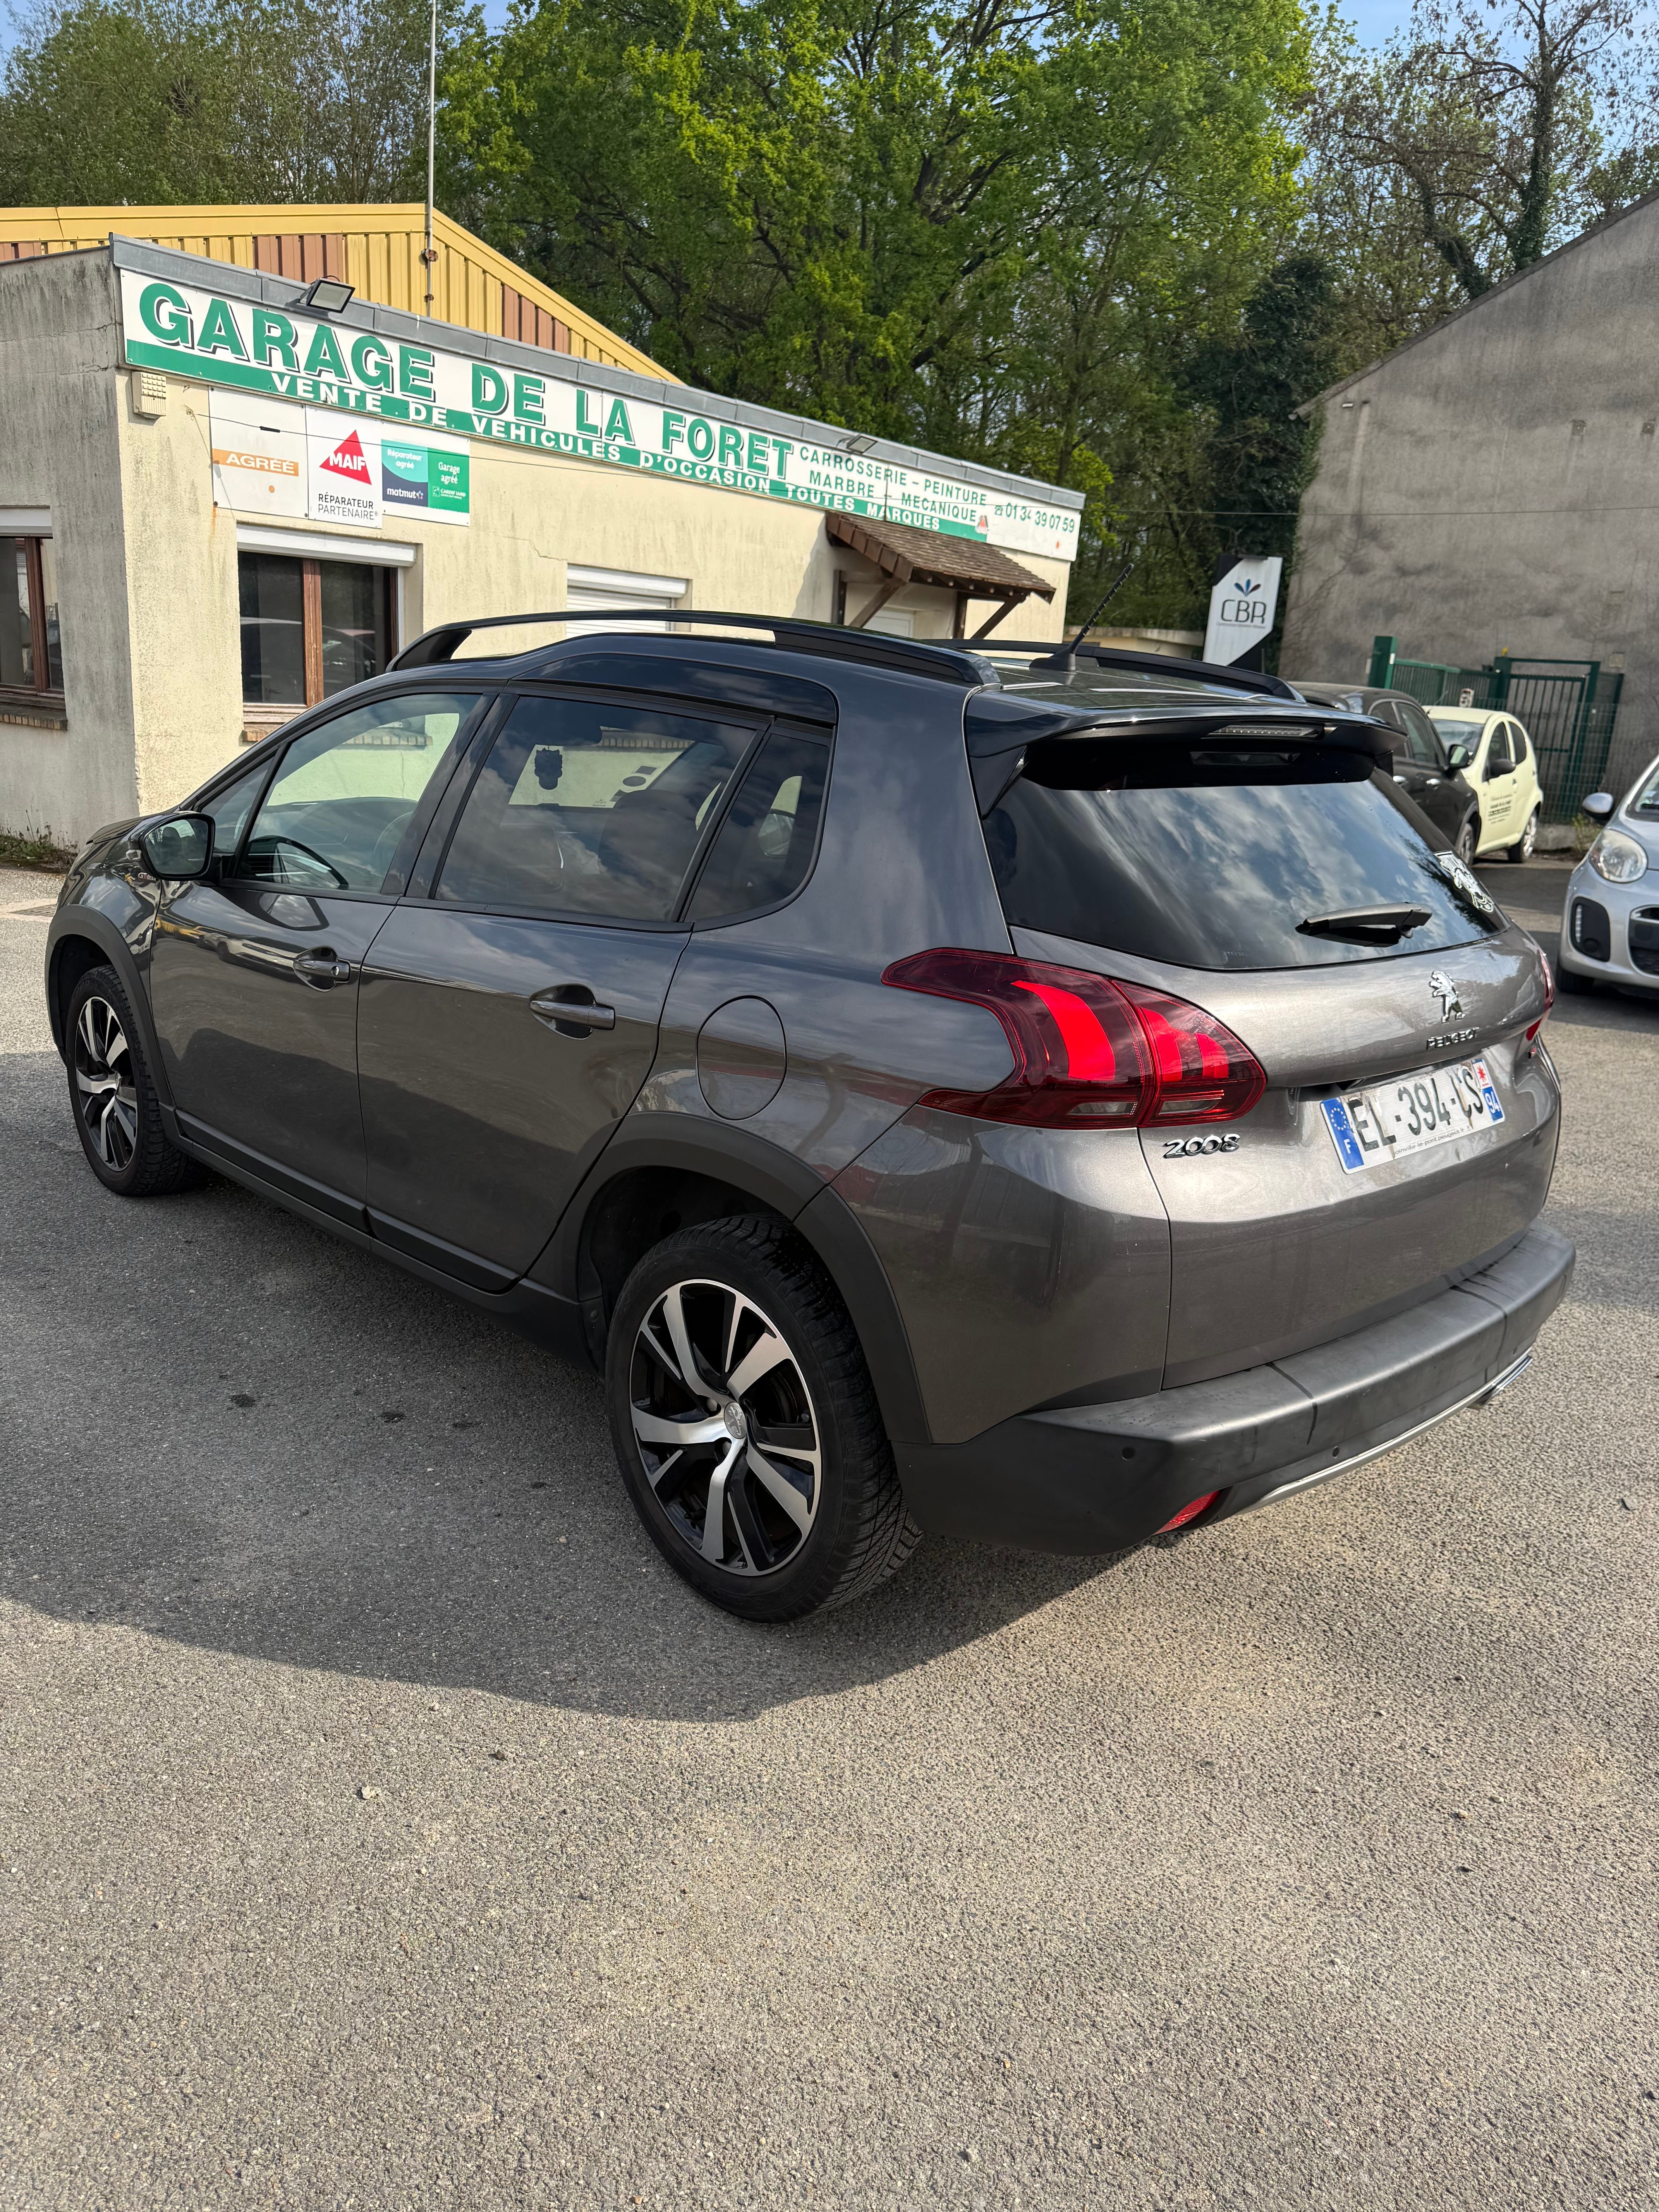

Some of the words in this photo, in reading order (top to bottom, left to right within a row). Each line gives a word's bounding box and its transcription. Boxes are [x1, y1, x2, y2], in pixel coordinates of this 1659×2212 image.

[139, 283, 435, 402] GARAGE
[472, 363, 545, 426] DE
[576, 389, 635, 446] LA
[662, 410, 793, 480] FORET
[271, 372, 382, 413] VENTE
[409, 401, 447, 426] DE
[471, 414, 620, 461] VEHICULES
[641, 451, 770, 494] D'OCCASION
[785, 483, 855, 512] TOUTES
[867, 502, 940, 531] MARQUES
[329, 452, 366, 472] MAIF
[387, 448, 422, 461] Réparateur
[226, 453, 294, 474] AGRÉÉ
[395, 460, 414, 469] agréé
[438, 462, 460, 475] Garage
[441, 475, 458, 484] agréé
[800, 446, 907, 486] CARROSSERIE
[924, 479, 987, 506] PEINTURE
[319, 493, 374, 510] RÉPARATEUR
[387, 488, 416, 499] matmut
[809, 470, 874, 498] MARBRE
[902, 492, 976, 522] MECANIQUE
[1035, 510, 1047, 527] 39
[1049, 514, 1061, 530] 07
[1062, 517, 1075, 533] 59
[1221, 599, 1267, 624] CBR
[1426, 1027, 1480, 1051] PEUGEOT
[1348, 1069, 1484, 1152] EL-394-CS
[1485, 1091, 1500, 1114] 94
[1163, 1133, 1240, 1159] 2008
[1344, 1139, 1351, 1154] F
